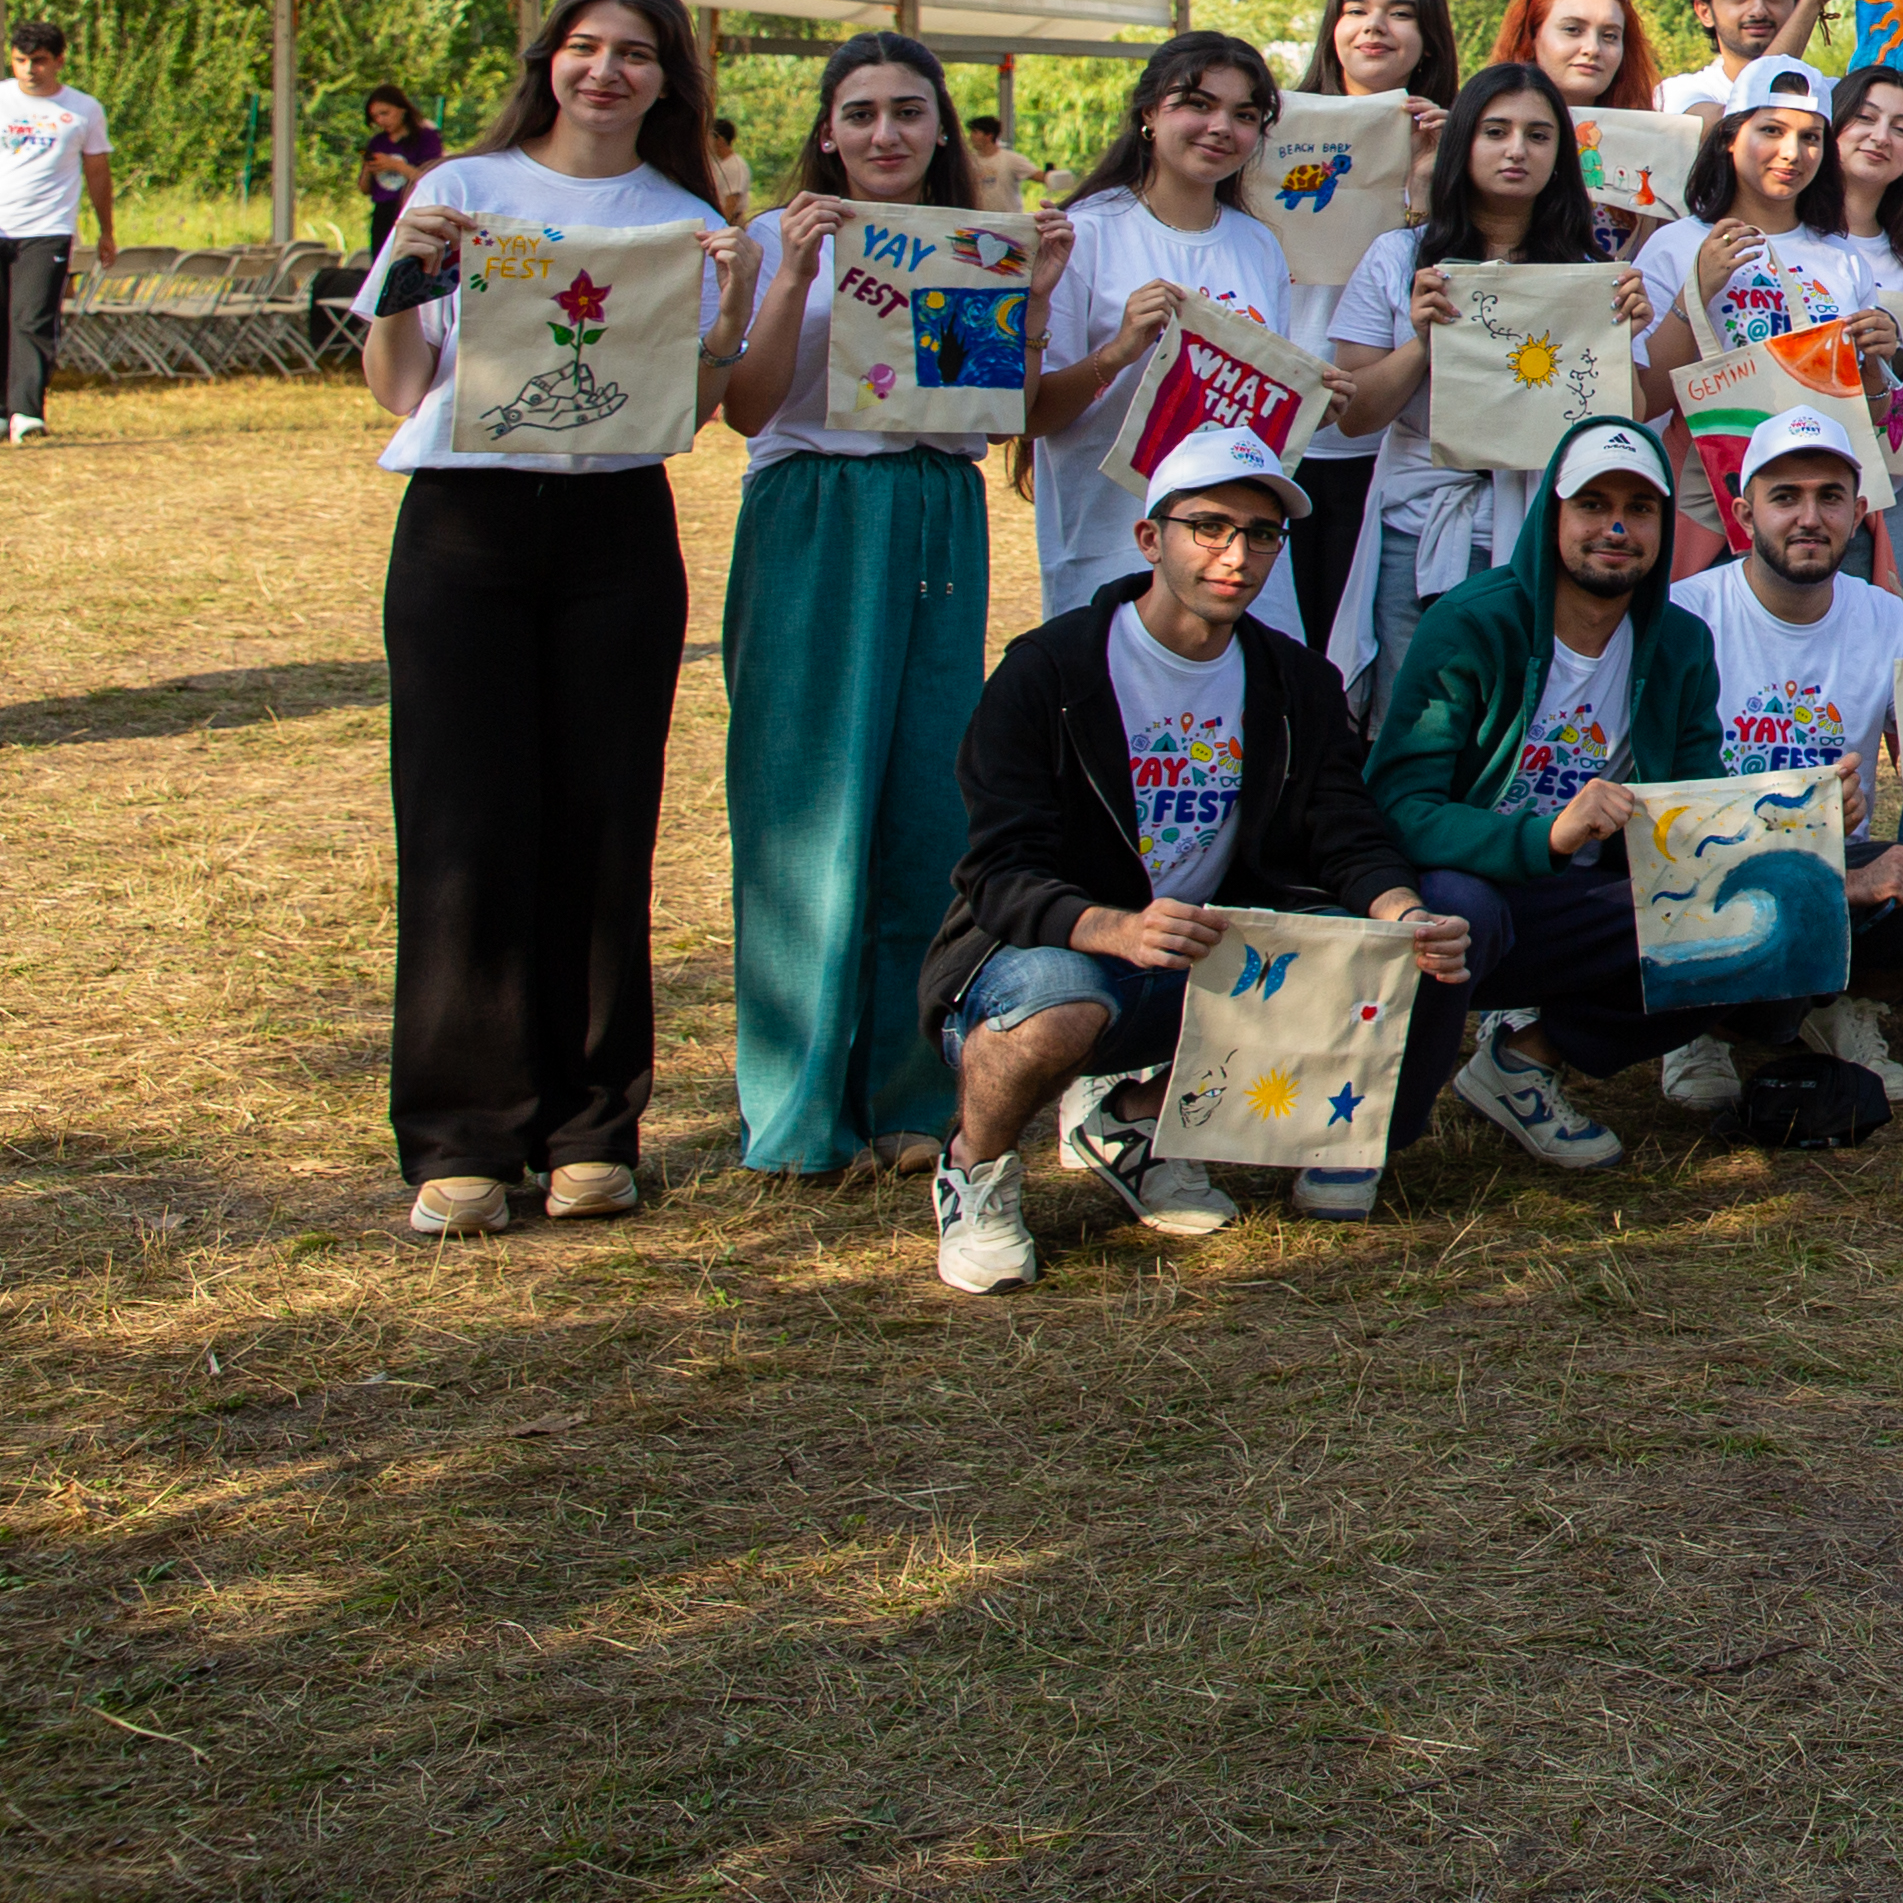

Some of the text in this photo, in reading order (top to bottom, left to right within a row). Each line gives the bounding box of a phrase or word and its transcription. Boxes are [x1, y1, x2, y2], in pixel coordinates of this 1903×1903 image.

[1278, 142, 1352, 158] BEACH BABY
[497, 235, 541, 255] YAY
[863, 224, 937, 272] YAY
[485, 256, 555, 280] FEST
[839, 267, 910, 319] FEST
[1726, 289, 1786, 311] YAY
[1187, 343, 1289, 418] WHAT
[1205, 389, 1255, 429] THE
[1733, 716, 1794, 744] YAY
